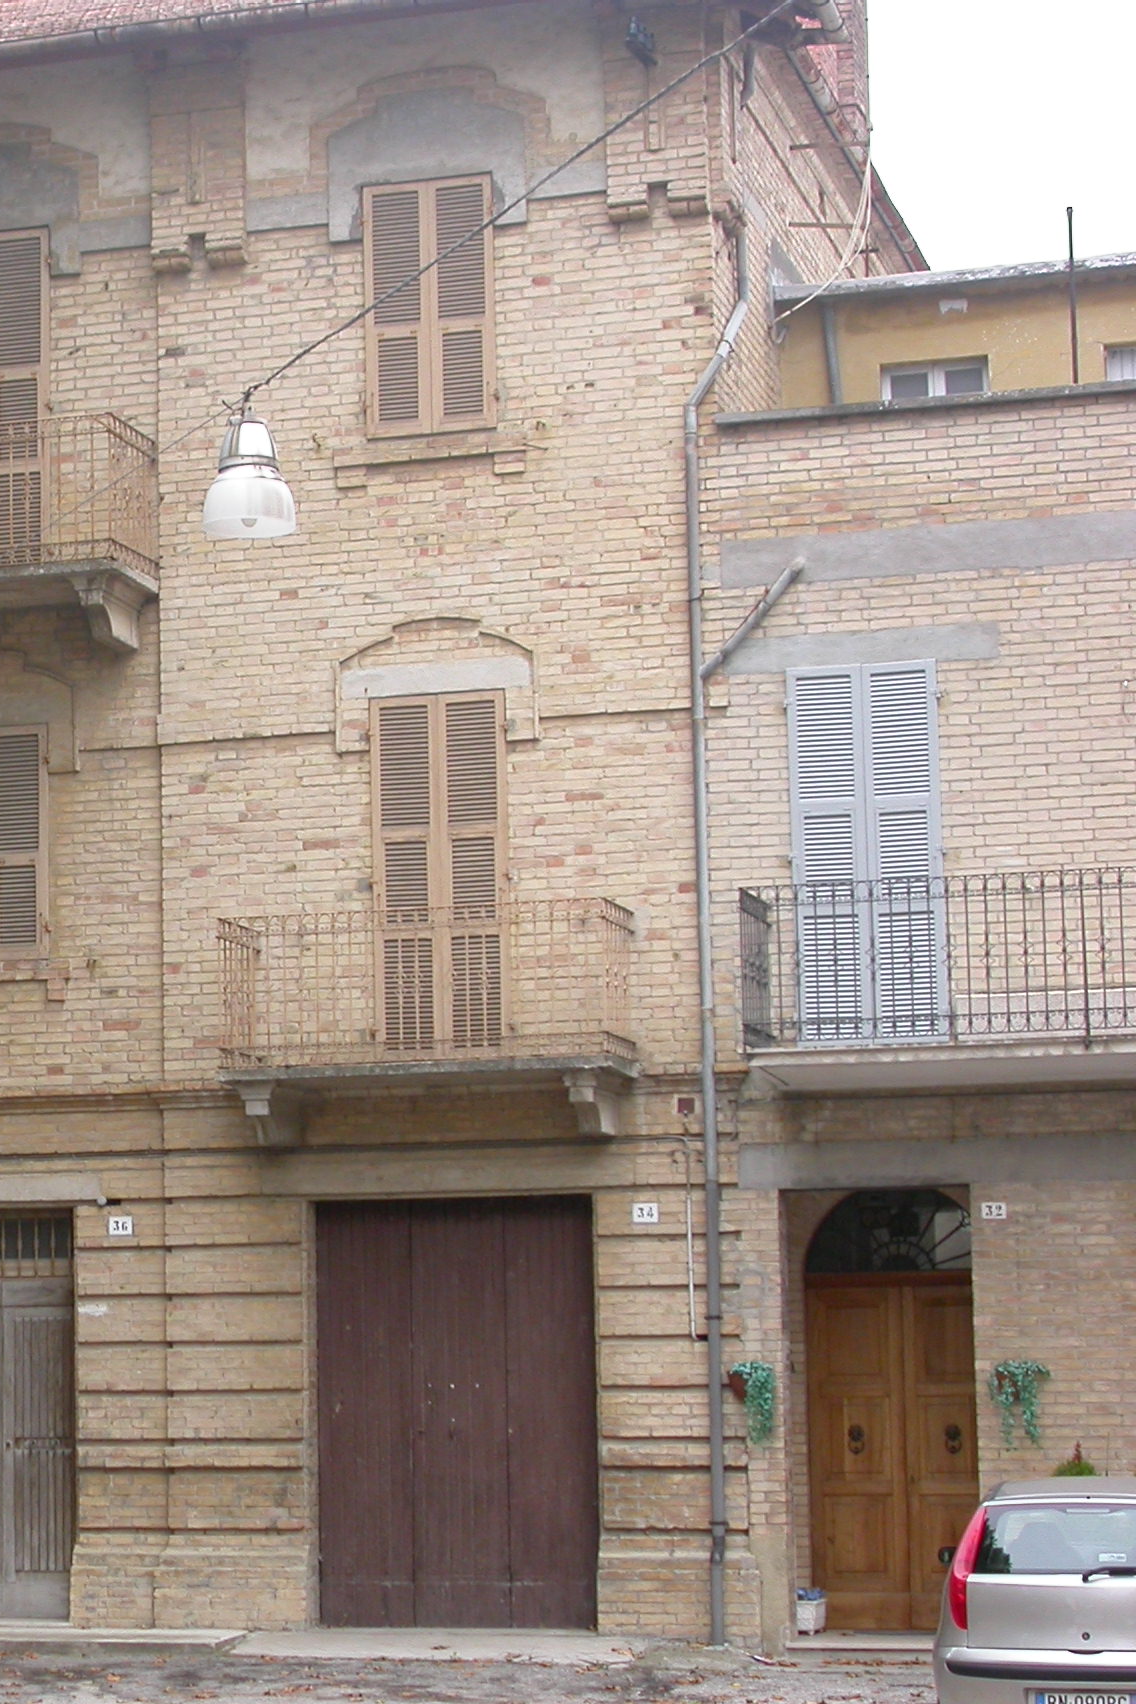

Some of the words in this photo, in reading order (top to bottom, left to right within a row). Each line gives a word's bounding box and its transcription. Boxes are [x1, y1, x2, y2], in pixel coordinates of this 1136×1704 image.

[636, 1205, 655, 1219] 34
[984, 1203, 1003, 1217] 32
[112, 1219, 129, 1232] 36
